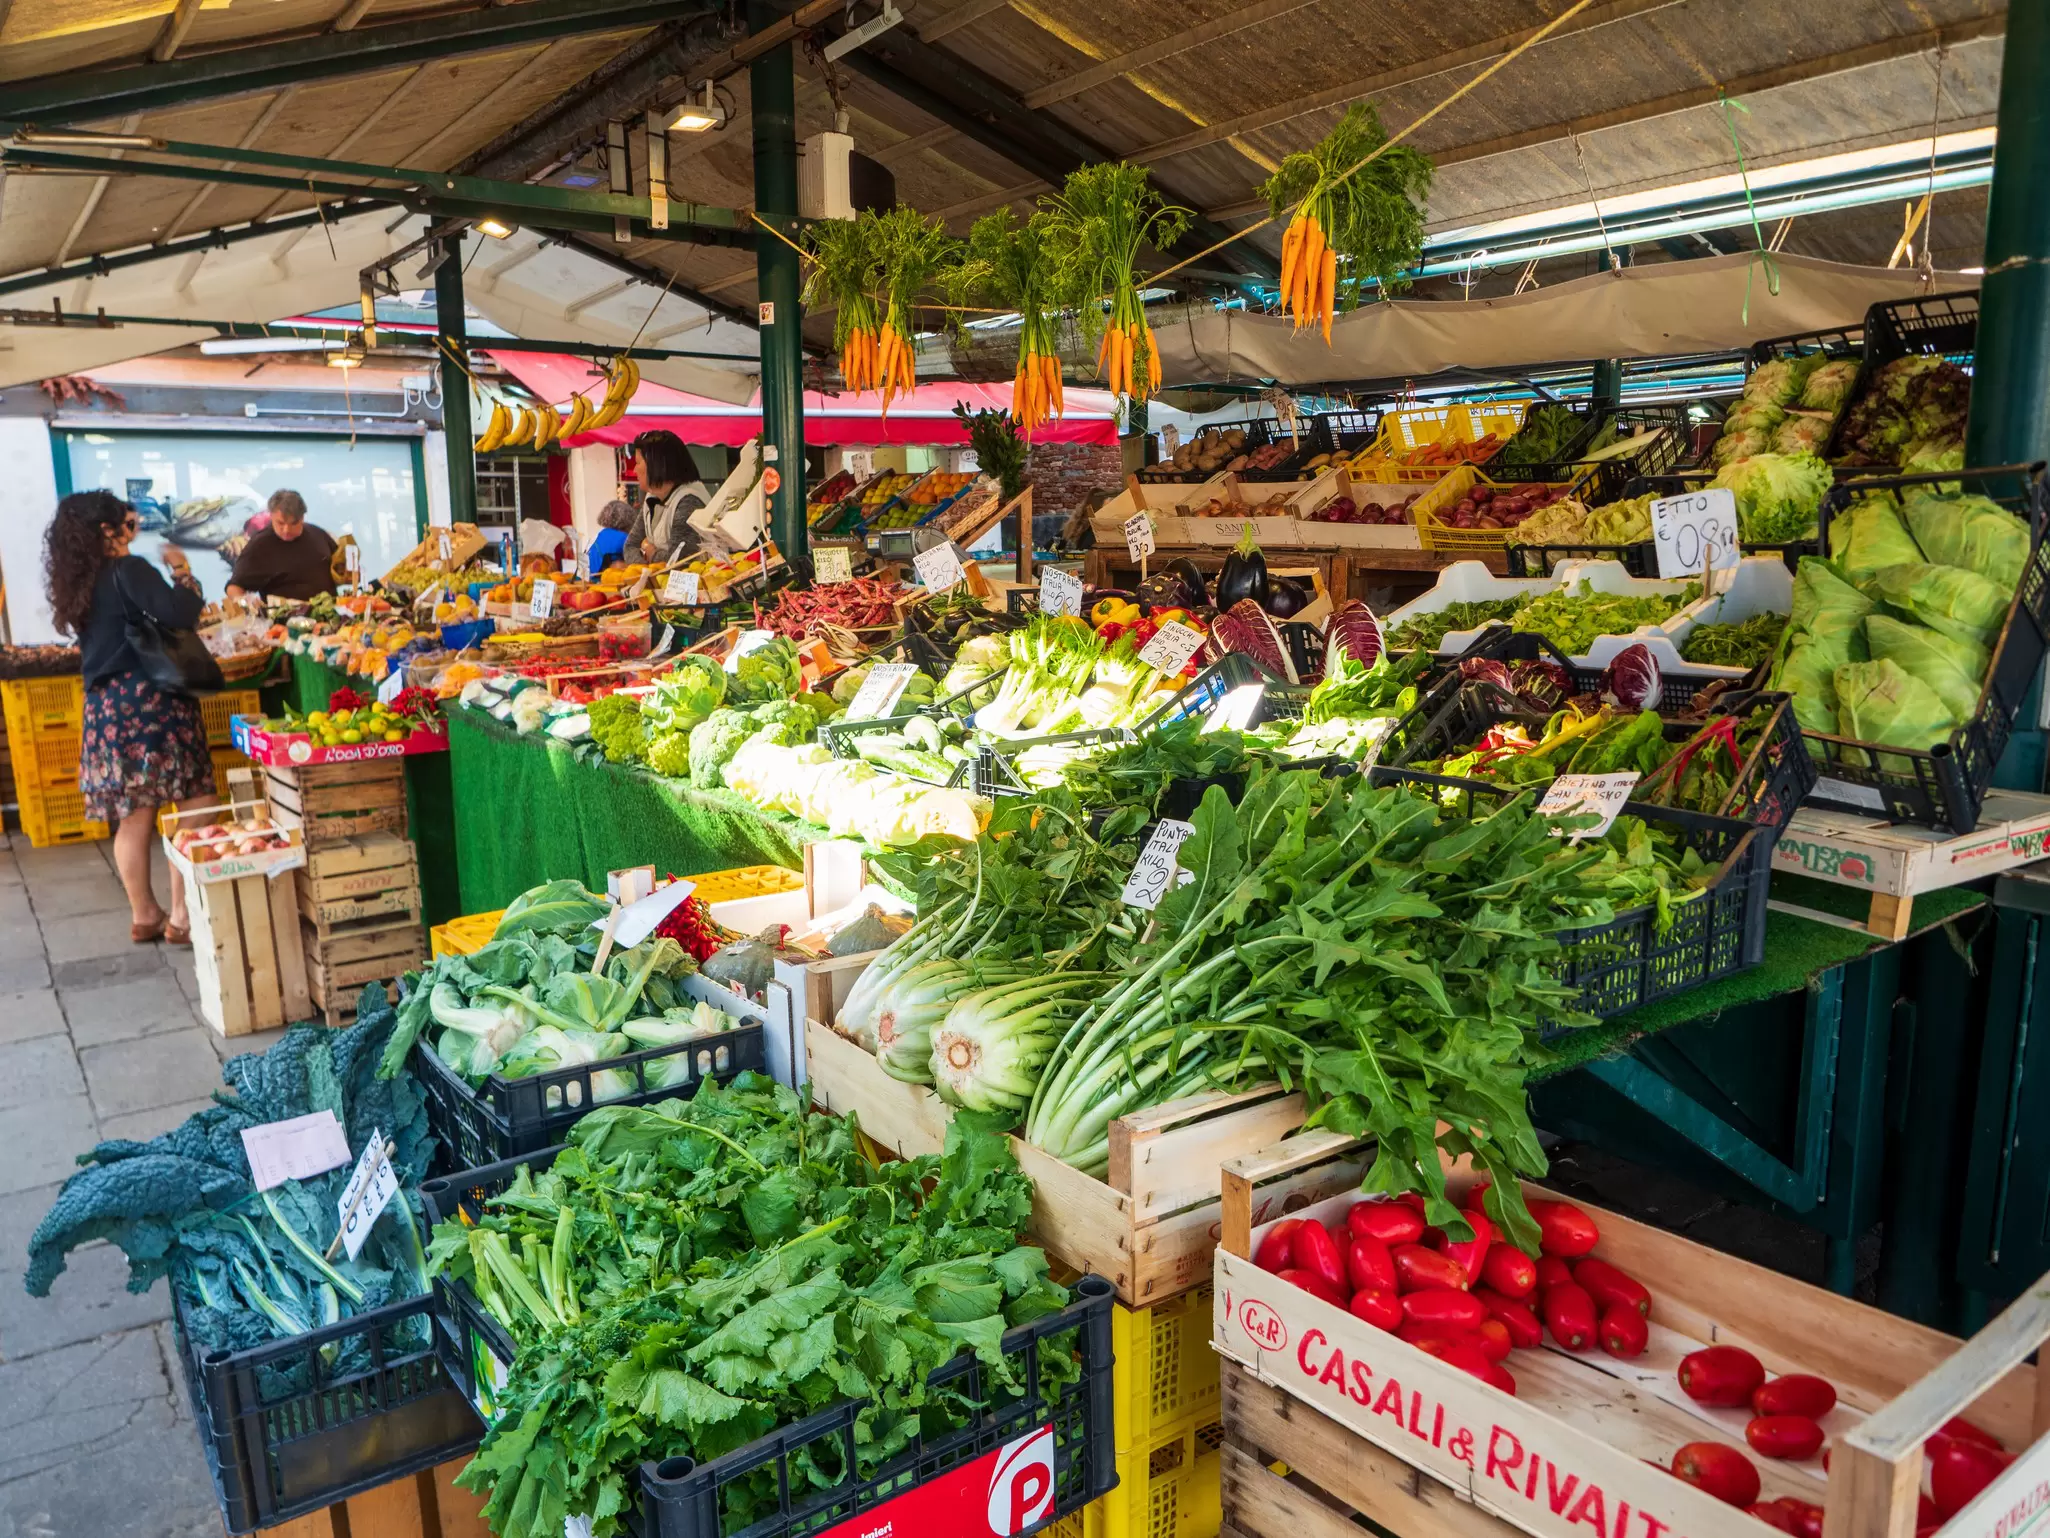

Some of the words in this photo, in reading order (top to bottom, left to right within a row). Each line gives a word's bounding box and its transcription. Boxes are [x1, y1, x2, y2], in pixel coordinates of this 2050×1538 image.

[1657, 496, 1708, 519] ETTO
[1043, 566, 1080, 589] NOSTRANE
[1158, 630, 1180, 643] ITALIA
[1165, 620, 1195, 640] FINOCCHI
[872, 664, 913, 672] NOSTRANI
[1147, 839, 1179, 854] ITALI
[1140, 853, 1165, 869] KILO
[1297, 1328, 1445, 1448] CASALI
[1447, 1426, 1476, 1470] &
[1485, 1423, 1683, 1538] RIVALT
